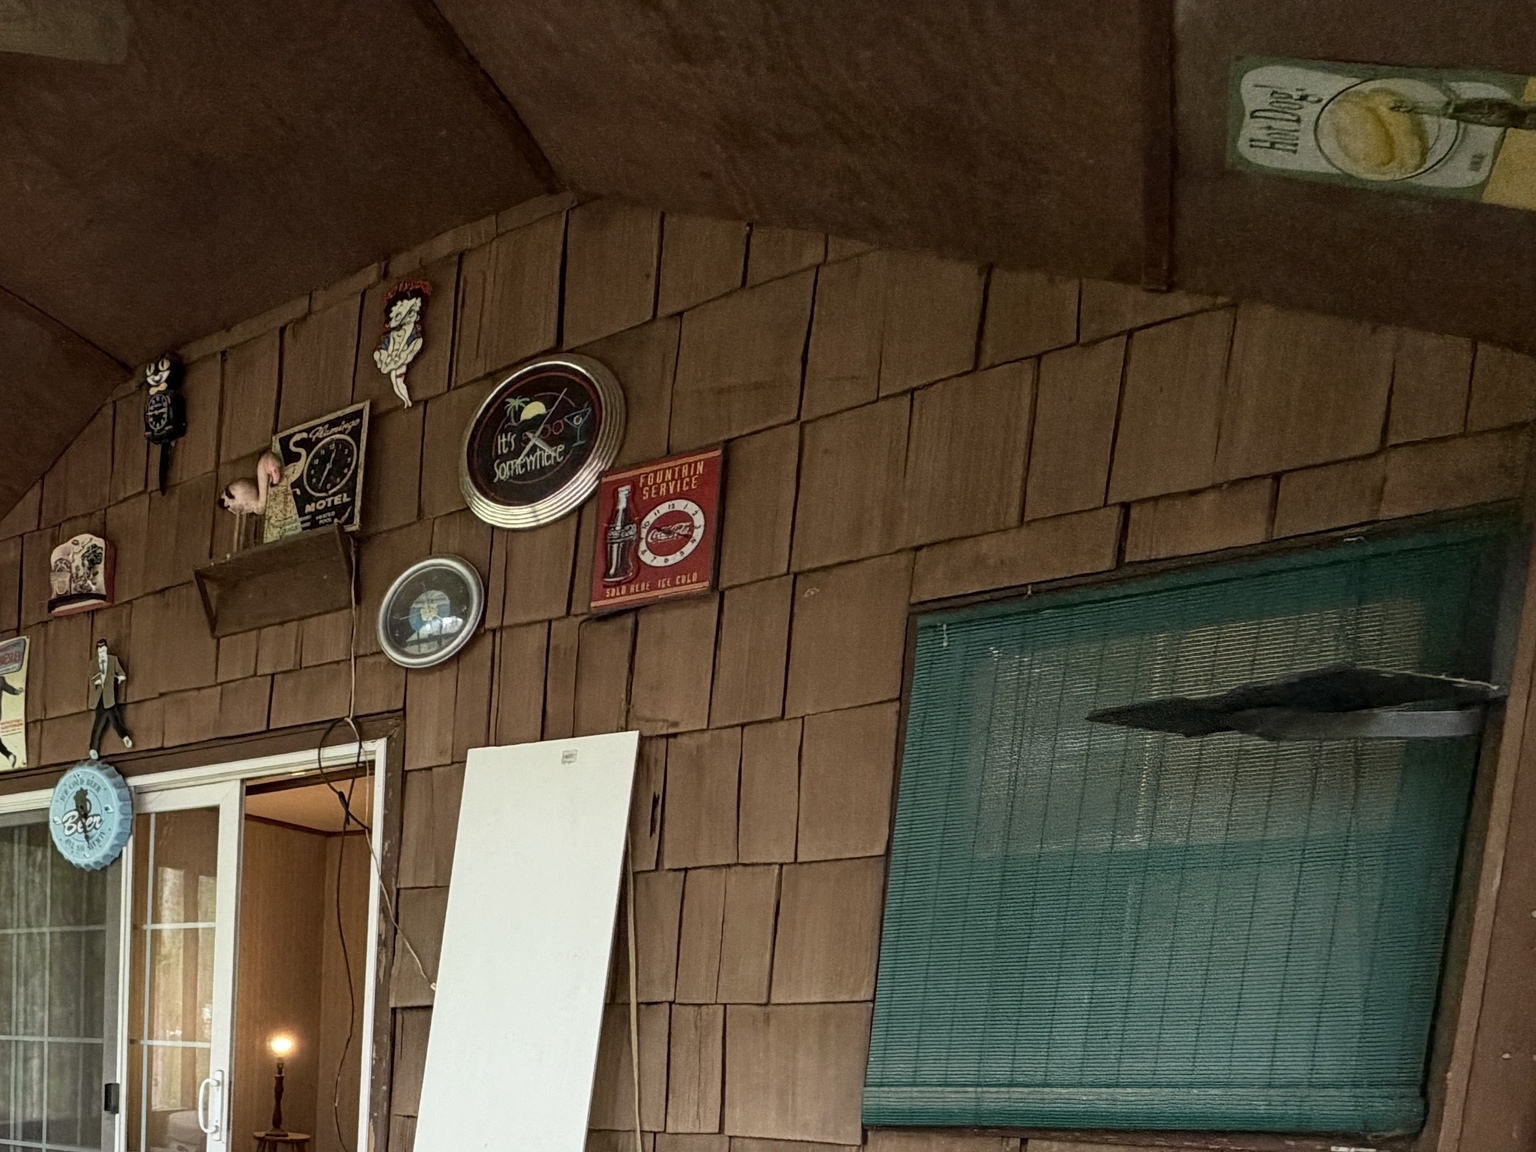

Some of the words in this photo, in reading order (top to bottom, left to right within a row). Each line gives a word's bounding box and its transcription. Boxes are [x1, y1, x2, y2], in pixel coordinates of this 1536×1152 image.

[1249, 125, 1300, 155] Hot
[498, 432, 516, 455] It's
[639, 461, 704, 487] FOUNTAIN
[642, 475, 699, 500] SERVICE
[304, 493, 352, 513] MOTEL
[606, 585, 627, 598] SOLD
[630, 581, 651, 593] HERE
[657, 578, 671, 588] ICE
[675, 572, 698, 585] COLD
[63, 809, 104, 836] Beer
